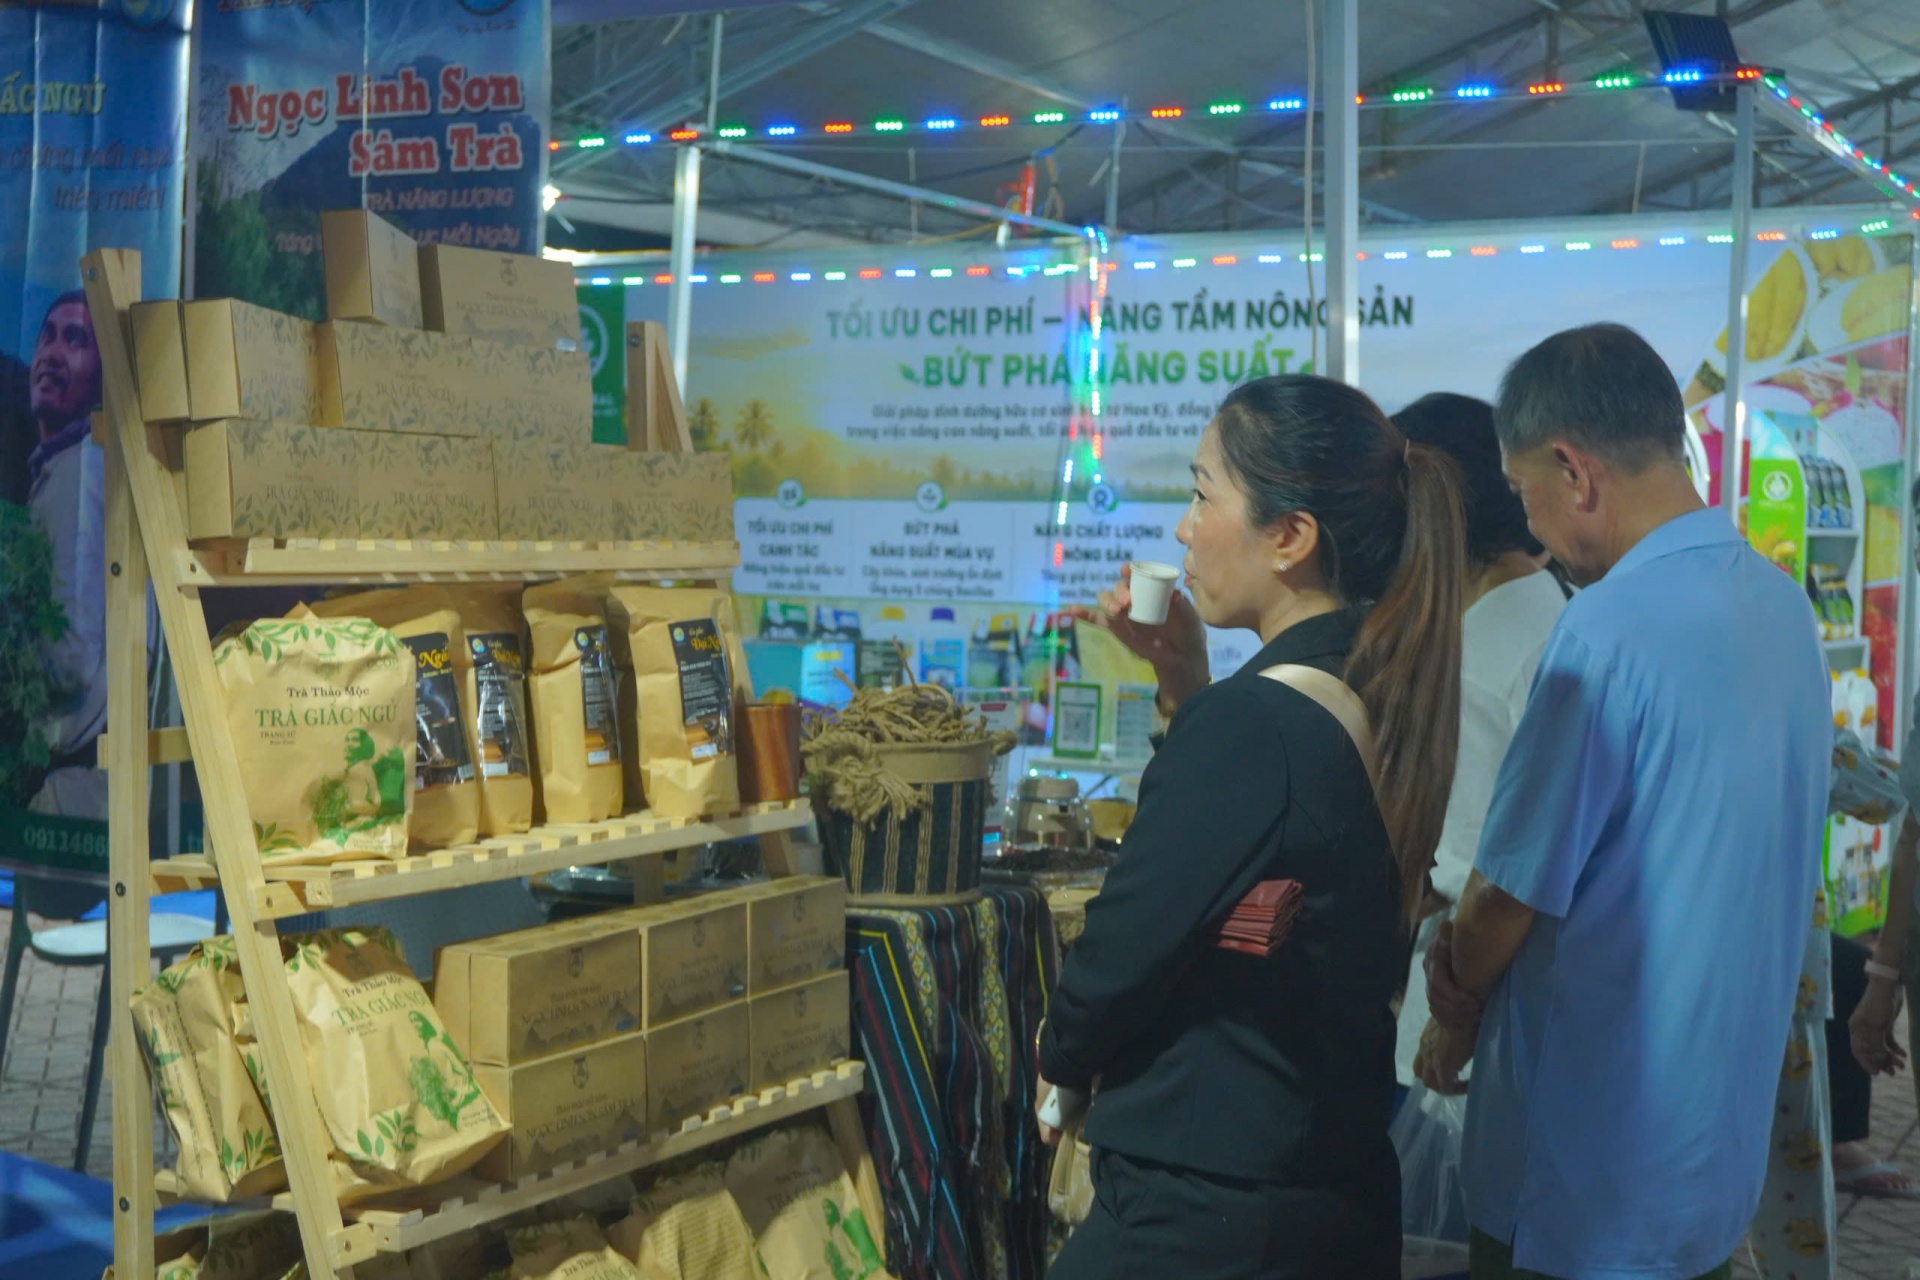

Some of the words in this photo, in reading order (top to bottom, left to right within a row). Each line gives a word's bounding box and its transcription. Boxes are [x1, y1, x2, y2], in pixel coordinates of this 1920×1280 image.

[228, 83, 326, 139] Ngọc
[335, 68, 429, 117] Linh
[350, 129, 439, 175] Sâm
[448, 123, 522, 170] Trà
[825, 296, 871, 338] TỐI
[881, 305, 919, 337] ƯU
[928, 306, 976, 336] CHI
[985, 295, 1035, 335] PHÍ
[1171, 287, 1236, 332] TẦM
[923, 345, 994, 387] BỨT
[1003, 345, 1072, 387] PHÁ
[1198, 333, 1294, 383] SUẤT
[255, 704, 298, 728] TRÀ
[304, 698, 353, 727] GIẤC
[359, 699, 398, 724] NGỦ
[286, 687, 308, 698] Trà
[311, 686, 341, 698] Thảo
